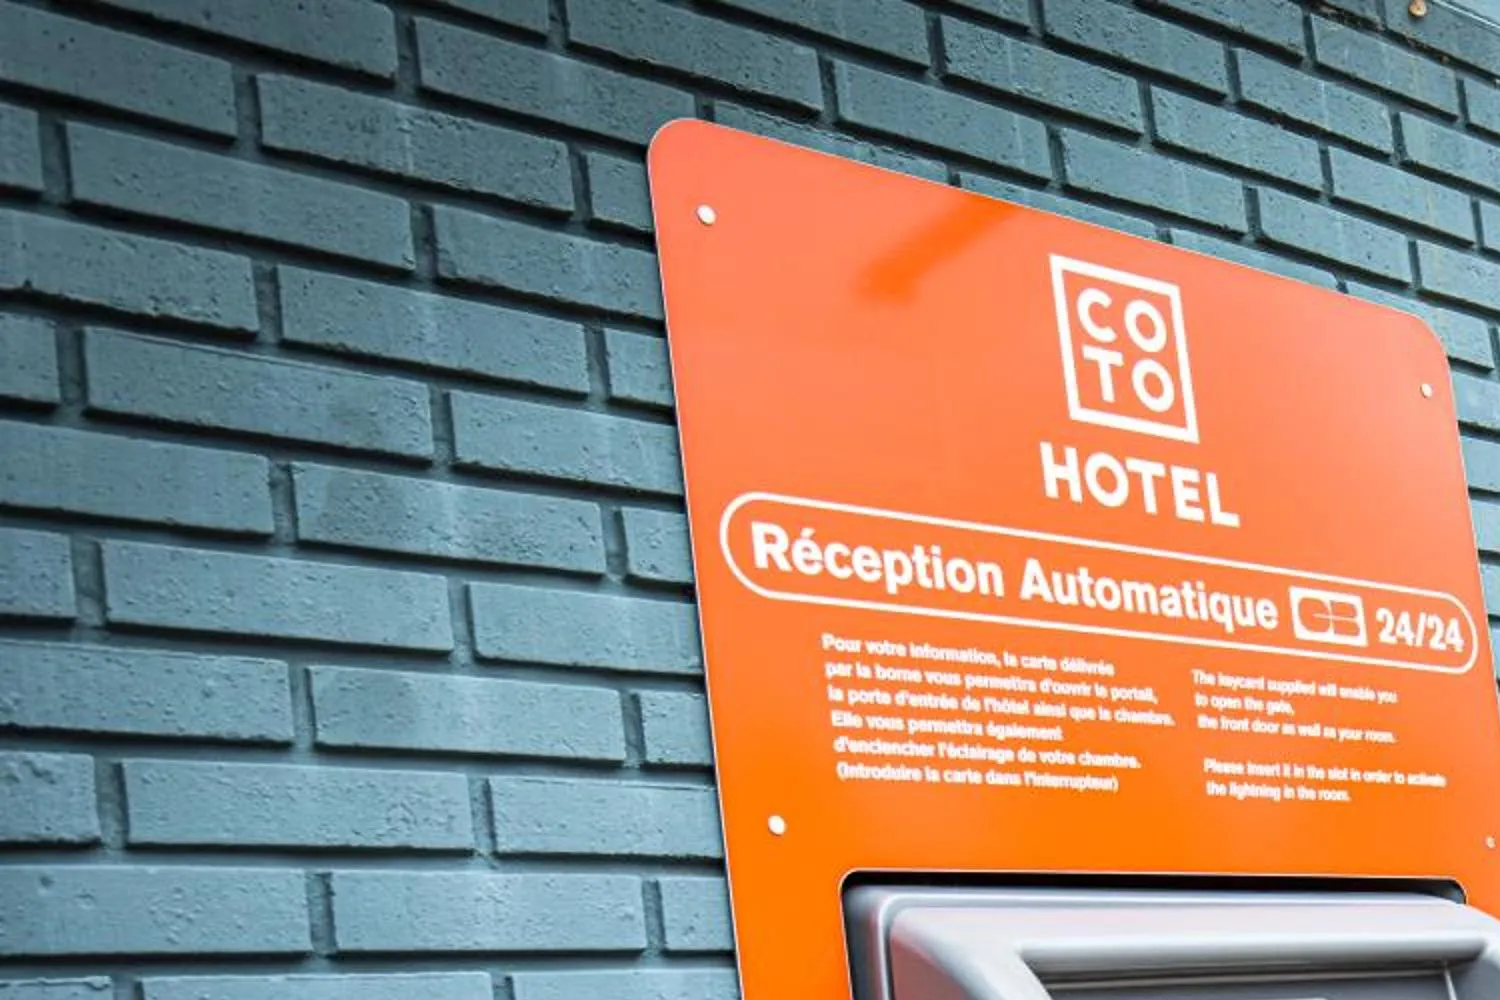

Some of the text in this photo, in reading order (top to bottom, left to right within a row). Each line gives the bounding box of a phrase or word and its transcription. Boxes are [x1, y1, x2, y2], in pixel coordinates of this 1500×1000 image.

[1040, 441, 1240, 528] HOTEL
[751, 521, 1004, 597] Réception
[1020, 558, 1278, 632] Automatique
[1376, 607, 1464, 652] 24/24
